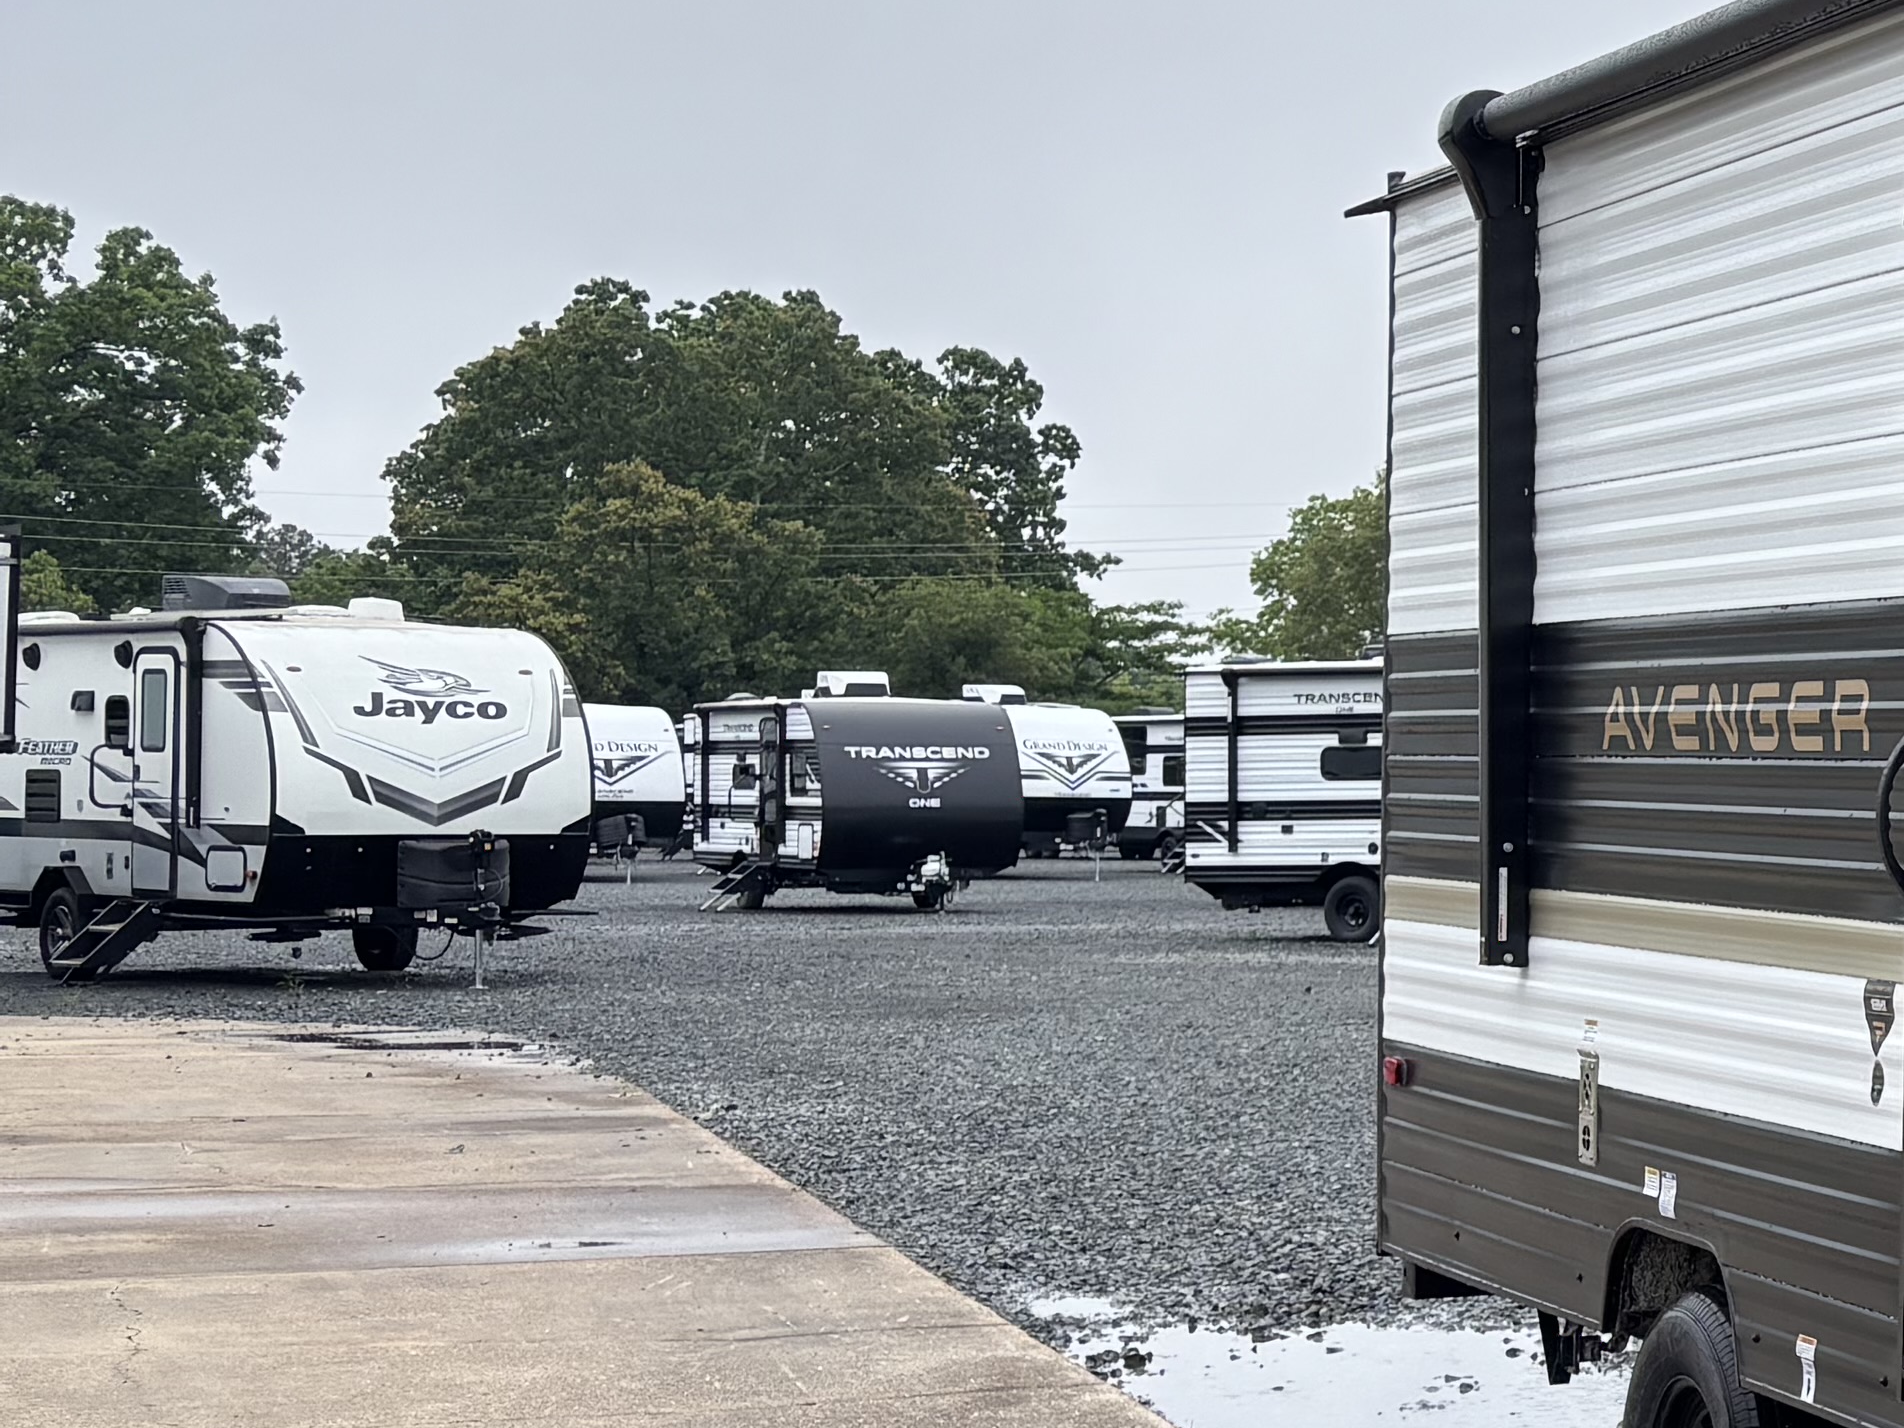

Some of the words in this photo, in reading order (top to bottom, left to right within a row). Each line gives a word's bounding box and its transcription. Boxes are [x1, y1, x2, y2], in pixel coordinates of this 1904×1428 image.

[1293, 692, 1384, 705] TRANSCEN
[353, 691, 508, 725] Jayco
[1602, 679, 1870, 752] AVENGER
[607, 740, 659, 753] DESIGN
[844, 746, 990, 759] TRANSCEND
[908, 798, 941, 808] ONE
